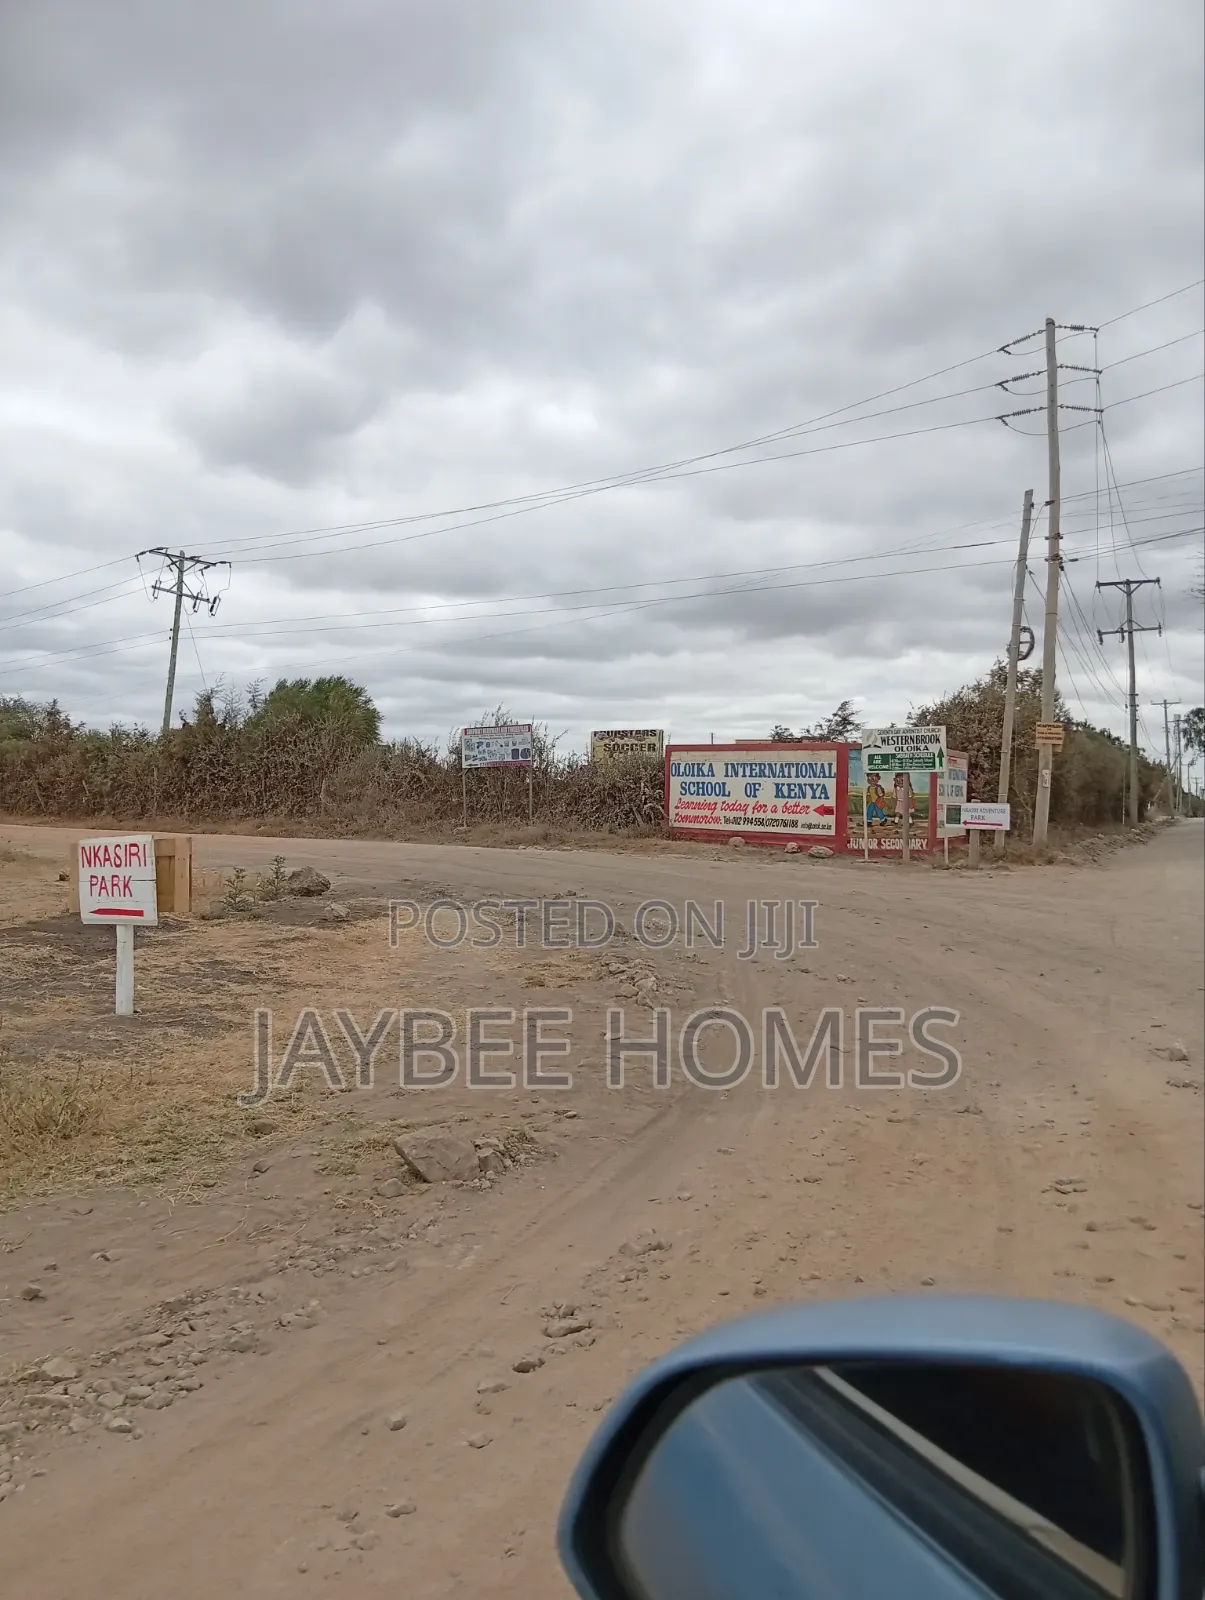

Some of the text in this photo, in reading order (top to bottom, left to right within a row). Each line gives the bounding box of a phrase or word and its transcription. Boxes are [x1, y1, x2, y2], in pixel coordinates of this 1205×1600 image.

[603, 743, 657, 752] SOCCER
[671, 762, 837, 779] OLOIKA INTERNATIONAL
[680, 781, 830, 800] SCHOOL OF KENYA
[674, 797, 811, 816] Learning today for a better
[847, 838, 928, 850] JUNOR SECONARY
[81, 843, 147, 868] NKASIRI
[89, 874, 133, 898] PARK
